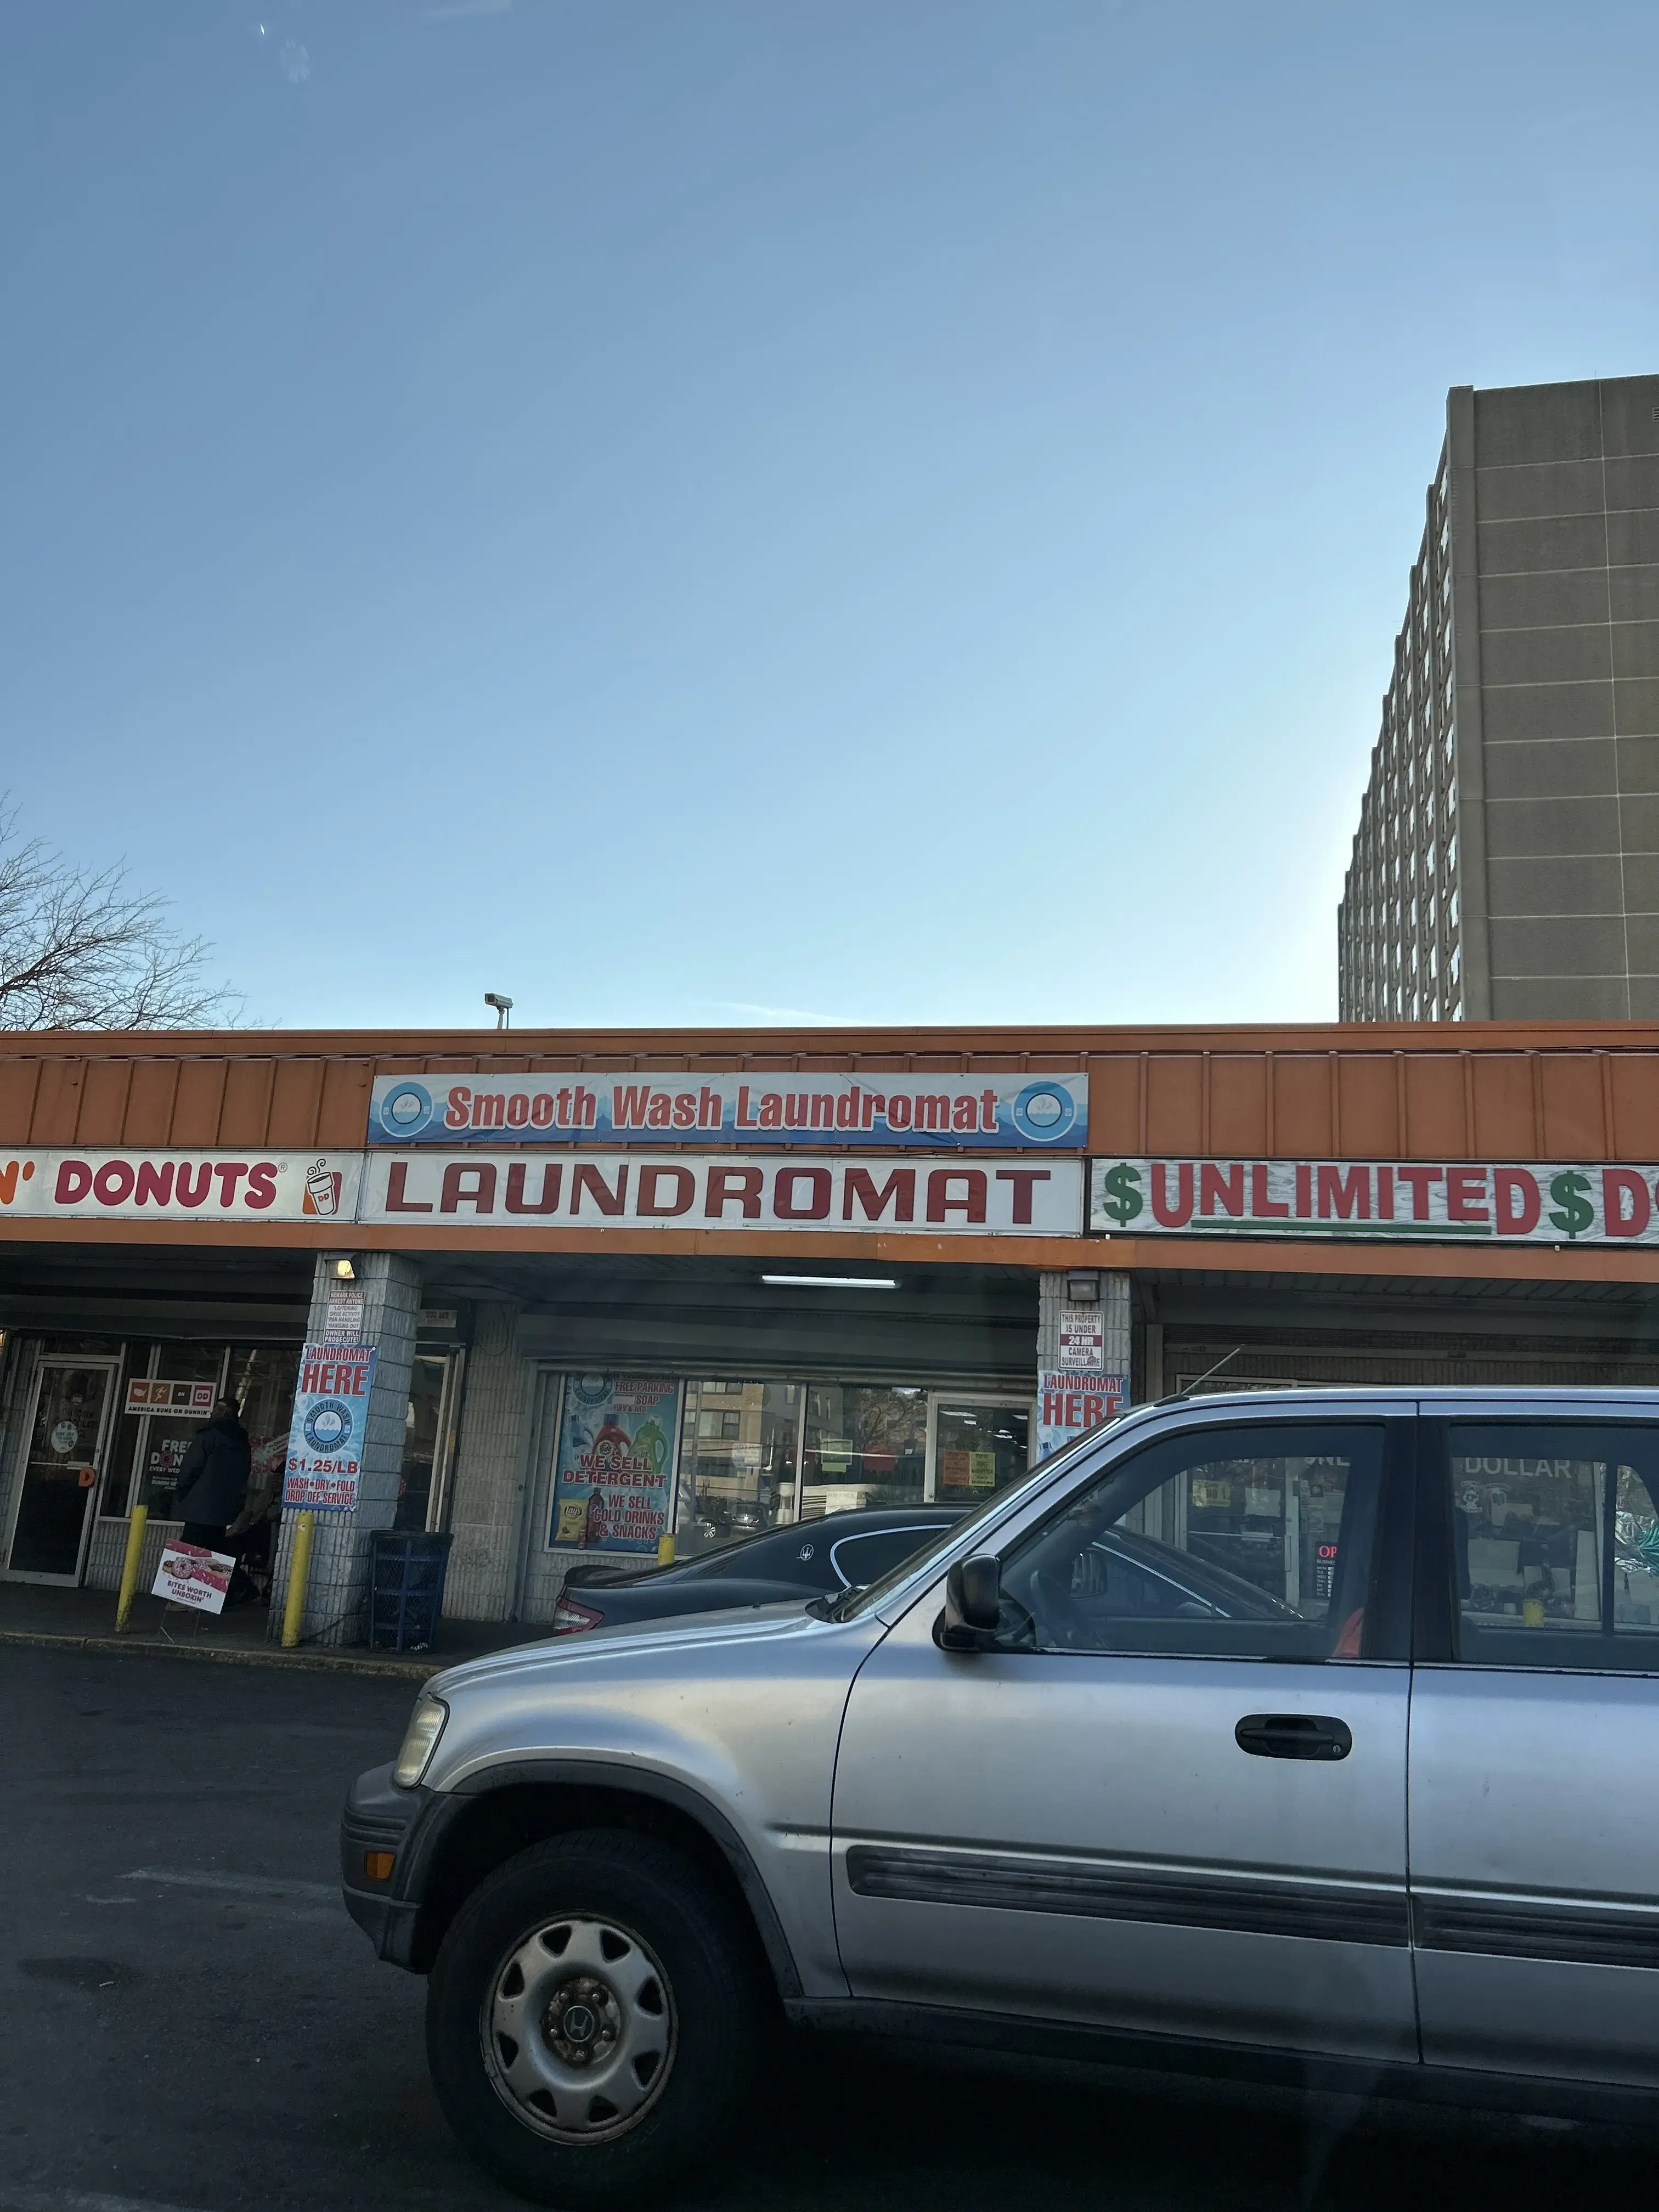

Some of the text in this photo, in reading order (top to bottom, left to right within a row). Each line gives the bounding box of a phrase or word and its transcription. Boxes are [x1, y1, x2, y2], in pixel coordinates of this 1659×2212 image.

[445, 1086, 998, 1130] Smooth Wash Laundromat
[385, 1161, 1051, 1224] LAUNDROMAT
[1602, 1168, 1659, 1238] D
[1062, 1314, 1101, 1323] THIS PROPERTY
[1066, 1324, 1096, 1334] IS UNDER
[1068, 1335, 1094, 1346] 24 HR
[306, 1347, 371, 1362] LAUNDROMAT
[1068, 1347, 1093, 1356] CAMERA
[302, 1363, 369, 1395] HERE
[615, 1381, 674, 1393] FREE PARKING
[1044, 1375, 1122, 1392] LAUNDROMAT
[636, 1395, 659, 1405] SOAP
[307, 1401, 351, 1425] SMOOTH WASH
[306, 1432, 348, 1453] LAUNDROMAT
[288, 1457, 358, 1474] $1.25/LB
[580, 1454, 605, 1468] WE
[610, 1455, 652, 1471] SELL
[1464, 1457, 1572, 1479] DOLLAR
[563, 1470, 667, 1488] DETERGENT
[285, 1490, 354, 1505] DROP OFF SERVICE
[608, 1494, 652, 1509] WE SELL
[594, 1509, 664, 1525] COLD DRINKS
[600, 1524, 657, 1540] & SNACKS
[167, 1581, 212, 1599] BITES WORTH
